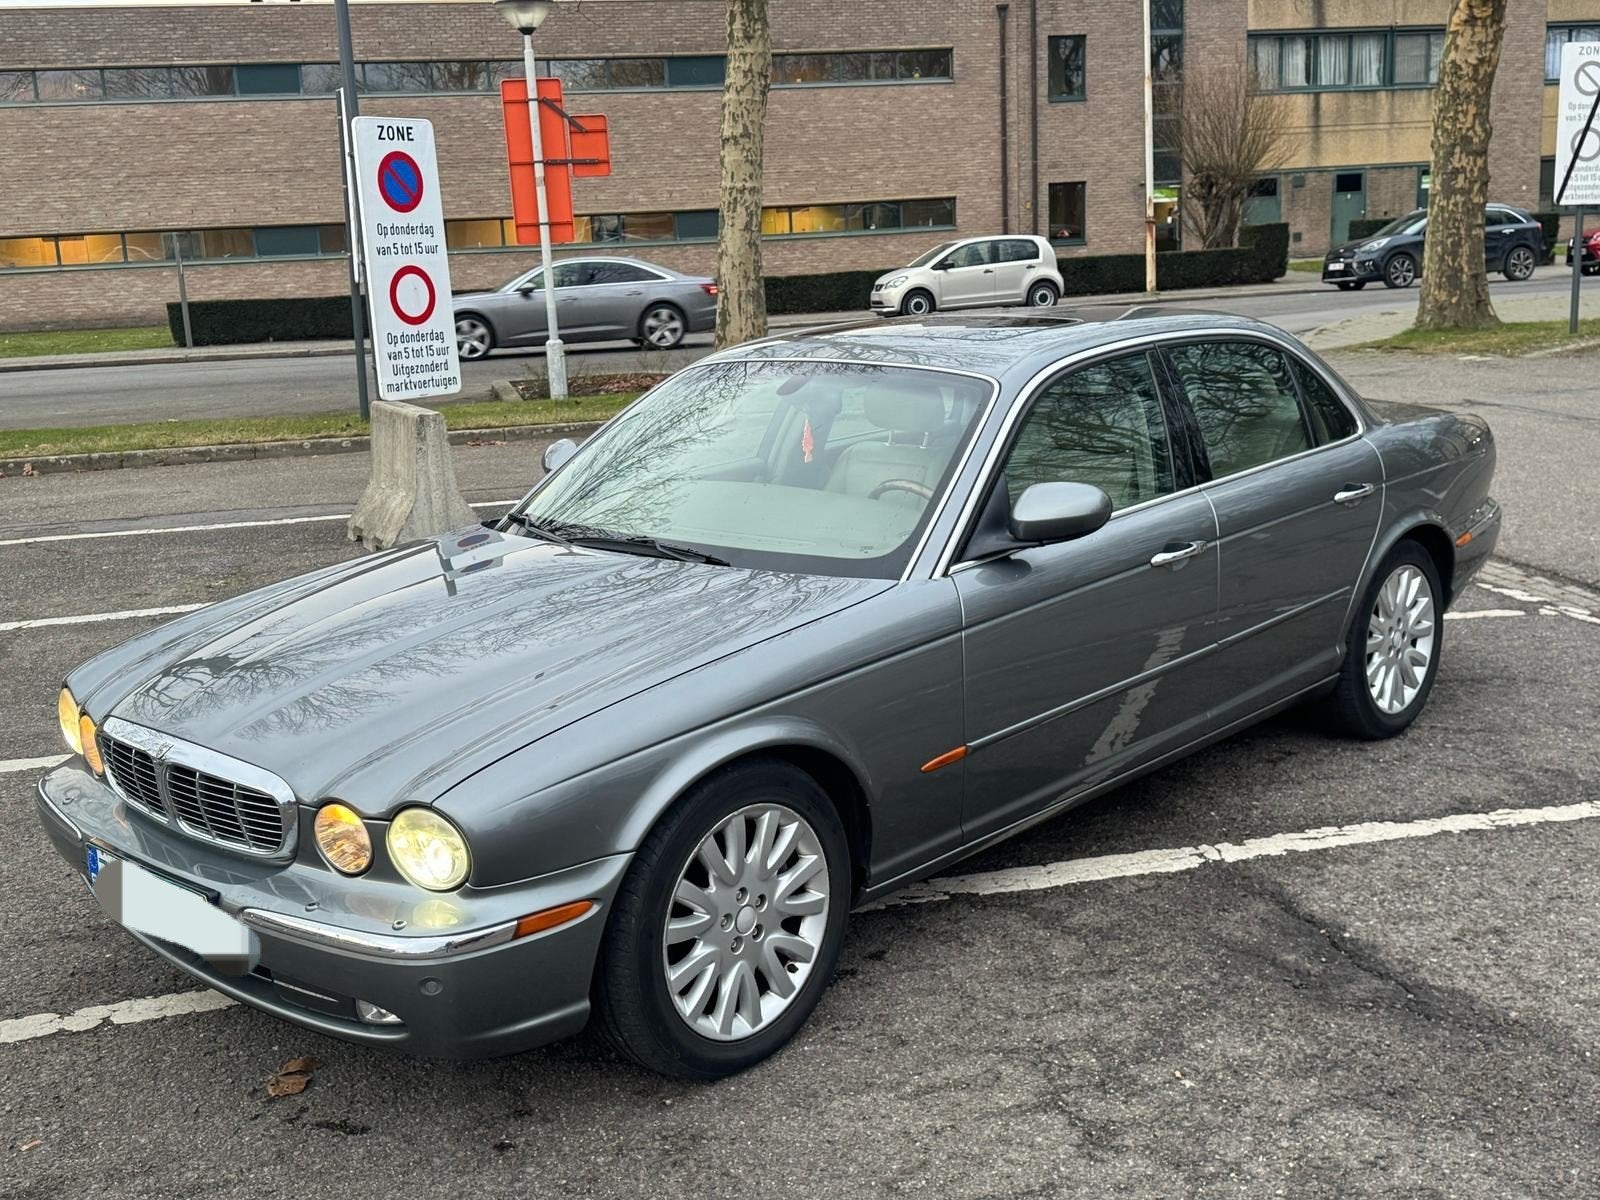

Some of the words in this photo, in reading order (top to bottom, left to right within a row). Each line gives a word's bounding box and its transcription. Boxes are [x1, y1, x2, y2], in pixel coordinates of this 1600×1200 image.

[1578, 46, 1600, 56] ZON
[376, 125, 415, 142] ZONE
[376, 222, 389, 239] Op
[389, 222, 435, 238] donderdag
[376, 246, 392, 256] van
[393, 243, 399, 256] 5
[400, 243, 413, 255] tot
[414, 242, 424, 255] 15
[424, 244, 439, 255] uur
[386, 332, 399, 347] Op
[399, 329, 445, 344] donderdag
[387, 350, 403, 361] van
[403, 347, 410, 360] 5
[411, 346, 424, 359] tot
[425, 344, 435, 358] 15
[435, 345, 450, 357] uur
[392, 358, 449, 378] Uitgezonderd
[386, 375, 458, 393] marktvoertuigen
